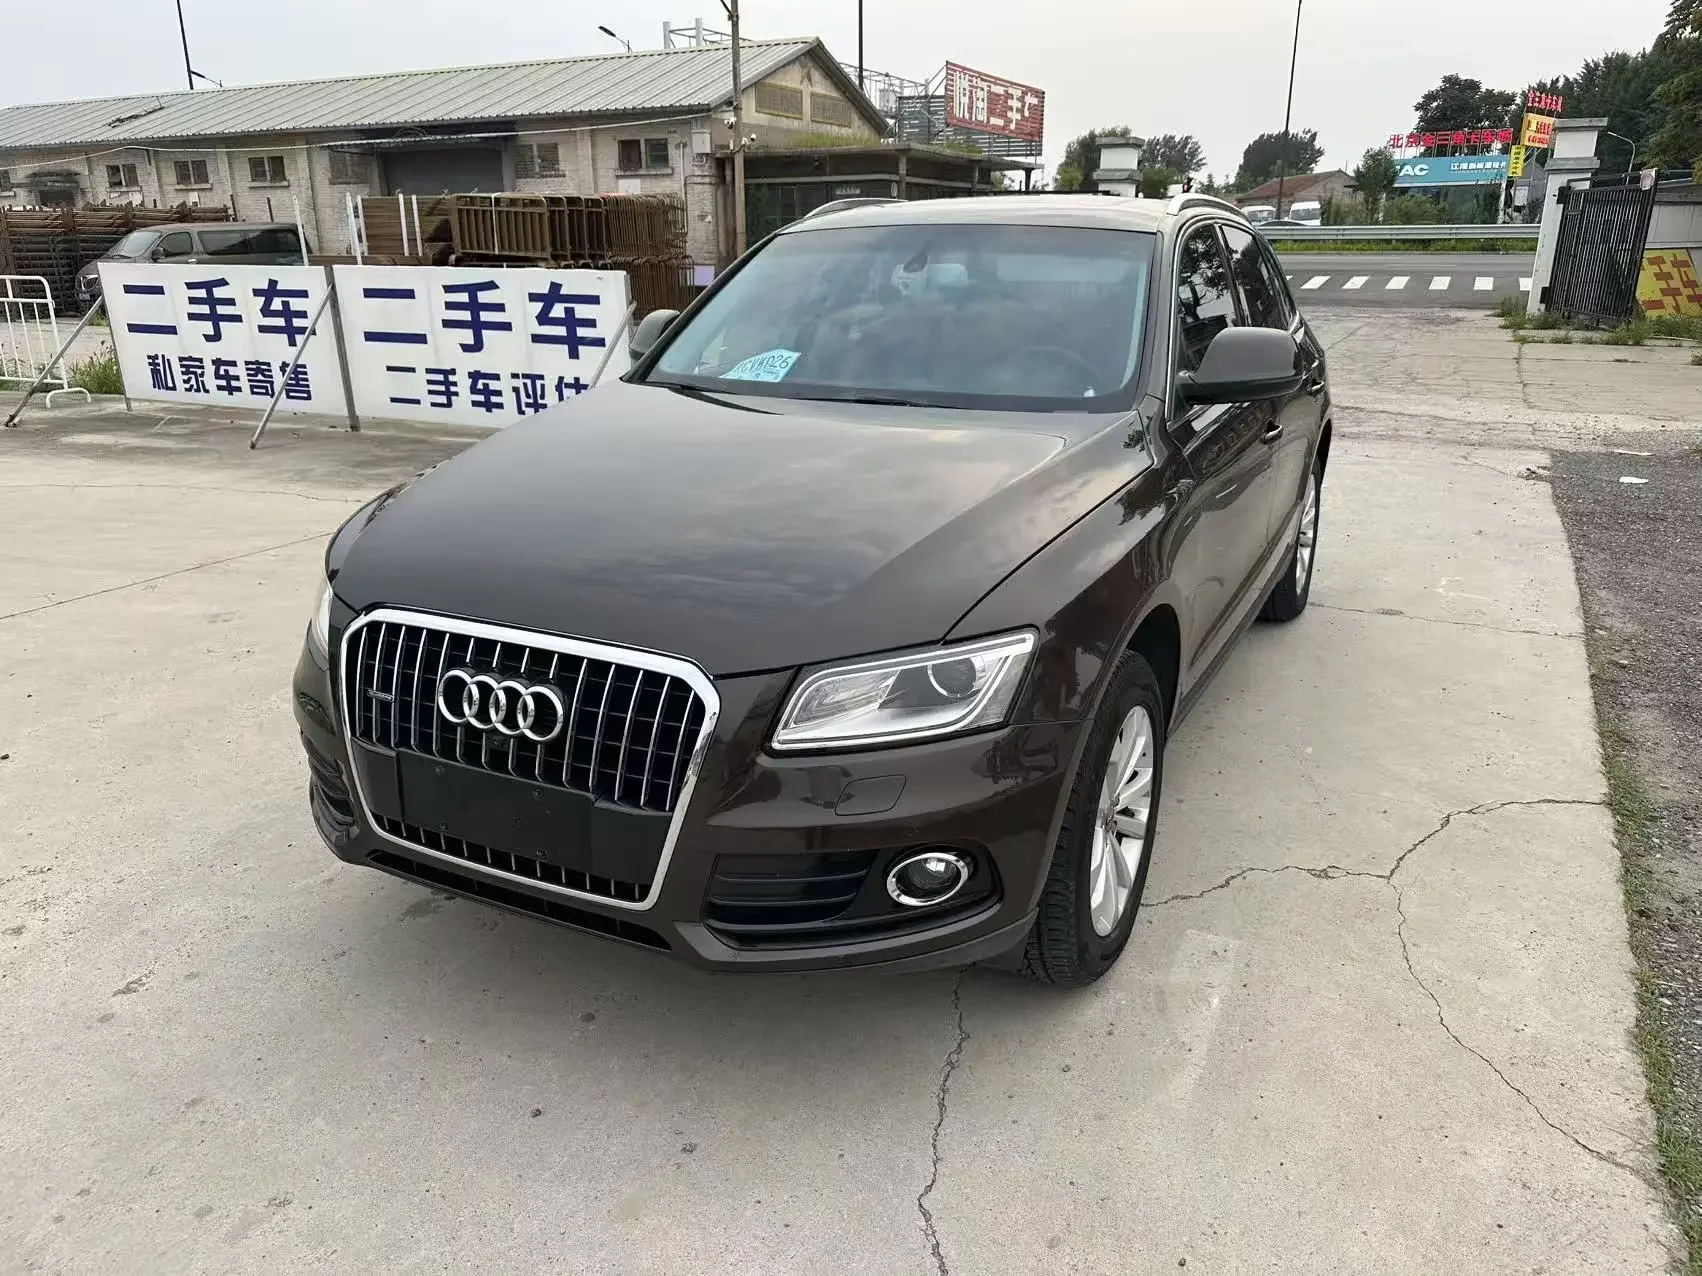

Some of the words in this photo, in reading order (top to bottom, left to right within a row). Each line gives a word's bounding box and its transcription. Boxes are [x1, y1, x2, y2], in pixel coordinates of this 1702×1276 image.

[122, 277, 317, 347] 二手车
[362, 280, 606, 360] 二手车
[147, 353, 312, 401] 私家车寄售
